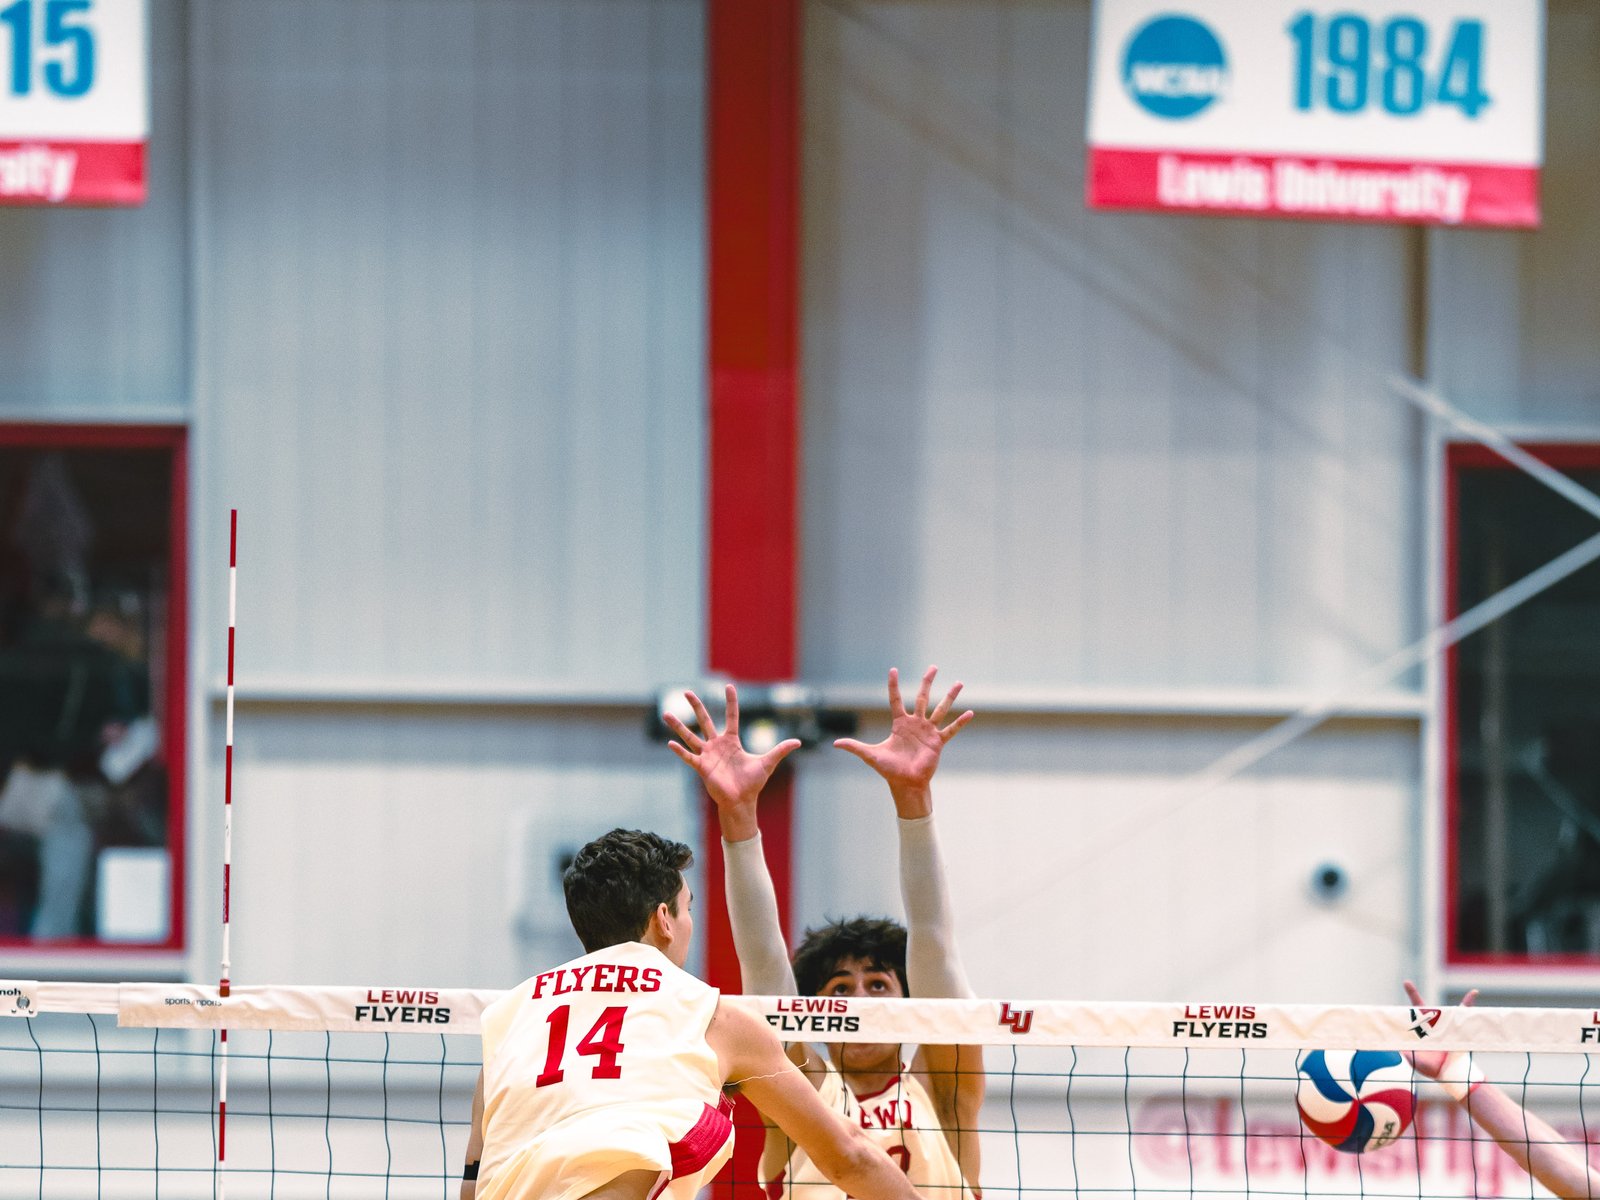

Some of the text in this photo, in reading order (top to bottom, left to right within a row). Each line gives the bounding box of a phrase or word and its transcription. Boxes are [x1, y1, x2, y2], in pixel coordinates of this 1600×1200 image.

[0, 0, 96, 97] 15
[1287, 11, 1491, 119] 1984
[1157, 153, 1470, 224] Lewis University
[531, 964, 662, 999] FLYERS
[366, 989, 439, 1005] LEWIS
[777, 998, 848, 1014] LEWIS
[354, 1005, 450, 1024] FLYERS
[765, 1014, 860, 1033] FLYERS
[998, 1001, 1033, 1035] LU
[1184, 1005, 1256, 1020] LEWIS
[1173, 1021, 1268, 1039] FLYERS
[536, 1004, 628, 1088] 14
